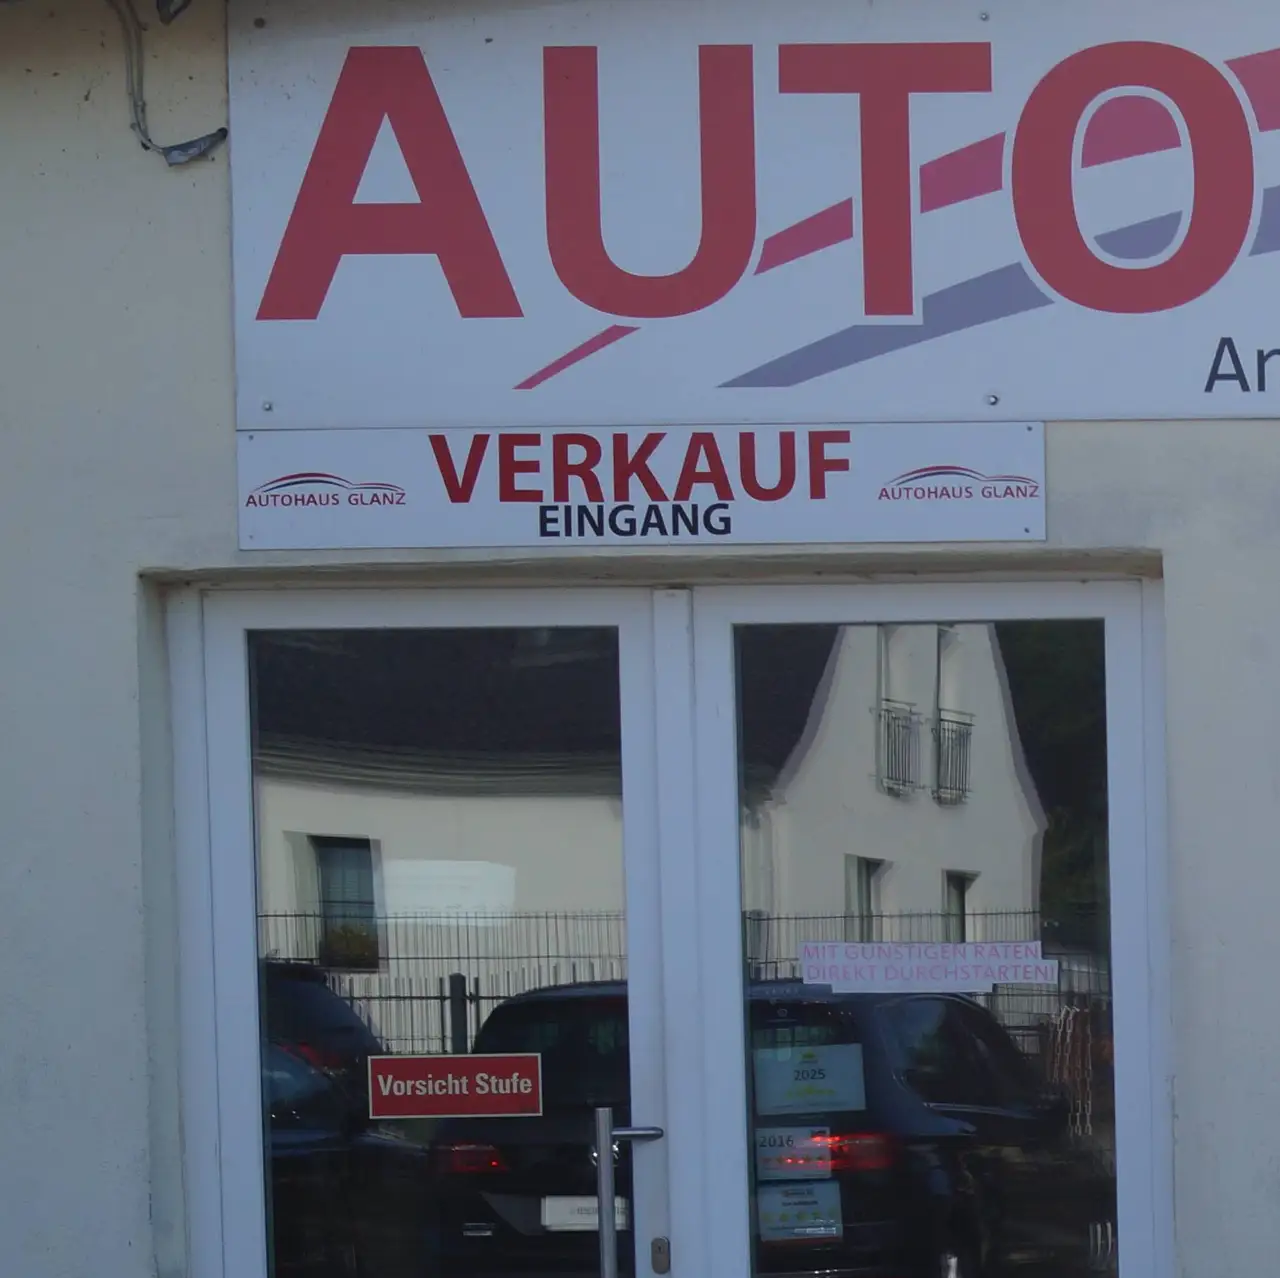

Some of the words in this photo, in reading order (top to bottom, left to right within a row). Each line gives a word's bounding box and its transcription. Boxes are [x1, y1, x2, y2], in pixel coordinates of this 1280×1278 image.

[428, 430, 851, 502] VERKAUF
[245, 492, 340, 508] AUTOHAUS
[347, 491, 407, 506] GLANZ
[877, 486, 973, 501] AUTOHAUS
[980, 485, 1040, 499] GLANZ
[538, 503, 733, 538] EINGANG
[803, 945, 842, 960] MIT
[974, 943, 1038, 960] RATEN
[807, 964, 877, 981] DIREKT
[884, 963, 1056, 981] DURCHSTARTEN!
[377, 1073, 469, 1096] Vorsicht
[475, 1072, 533, 1094] Stufe
